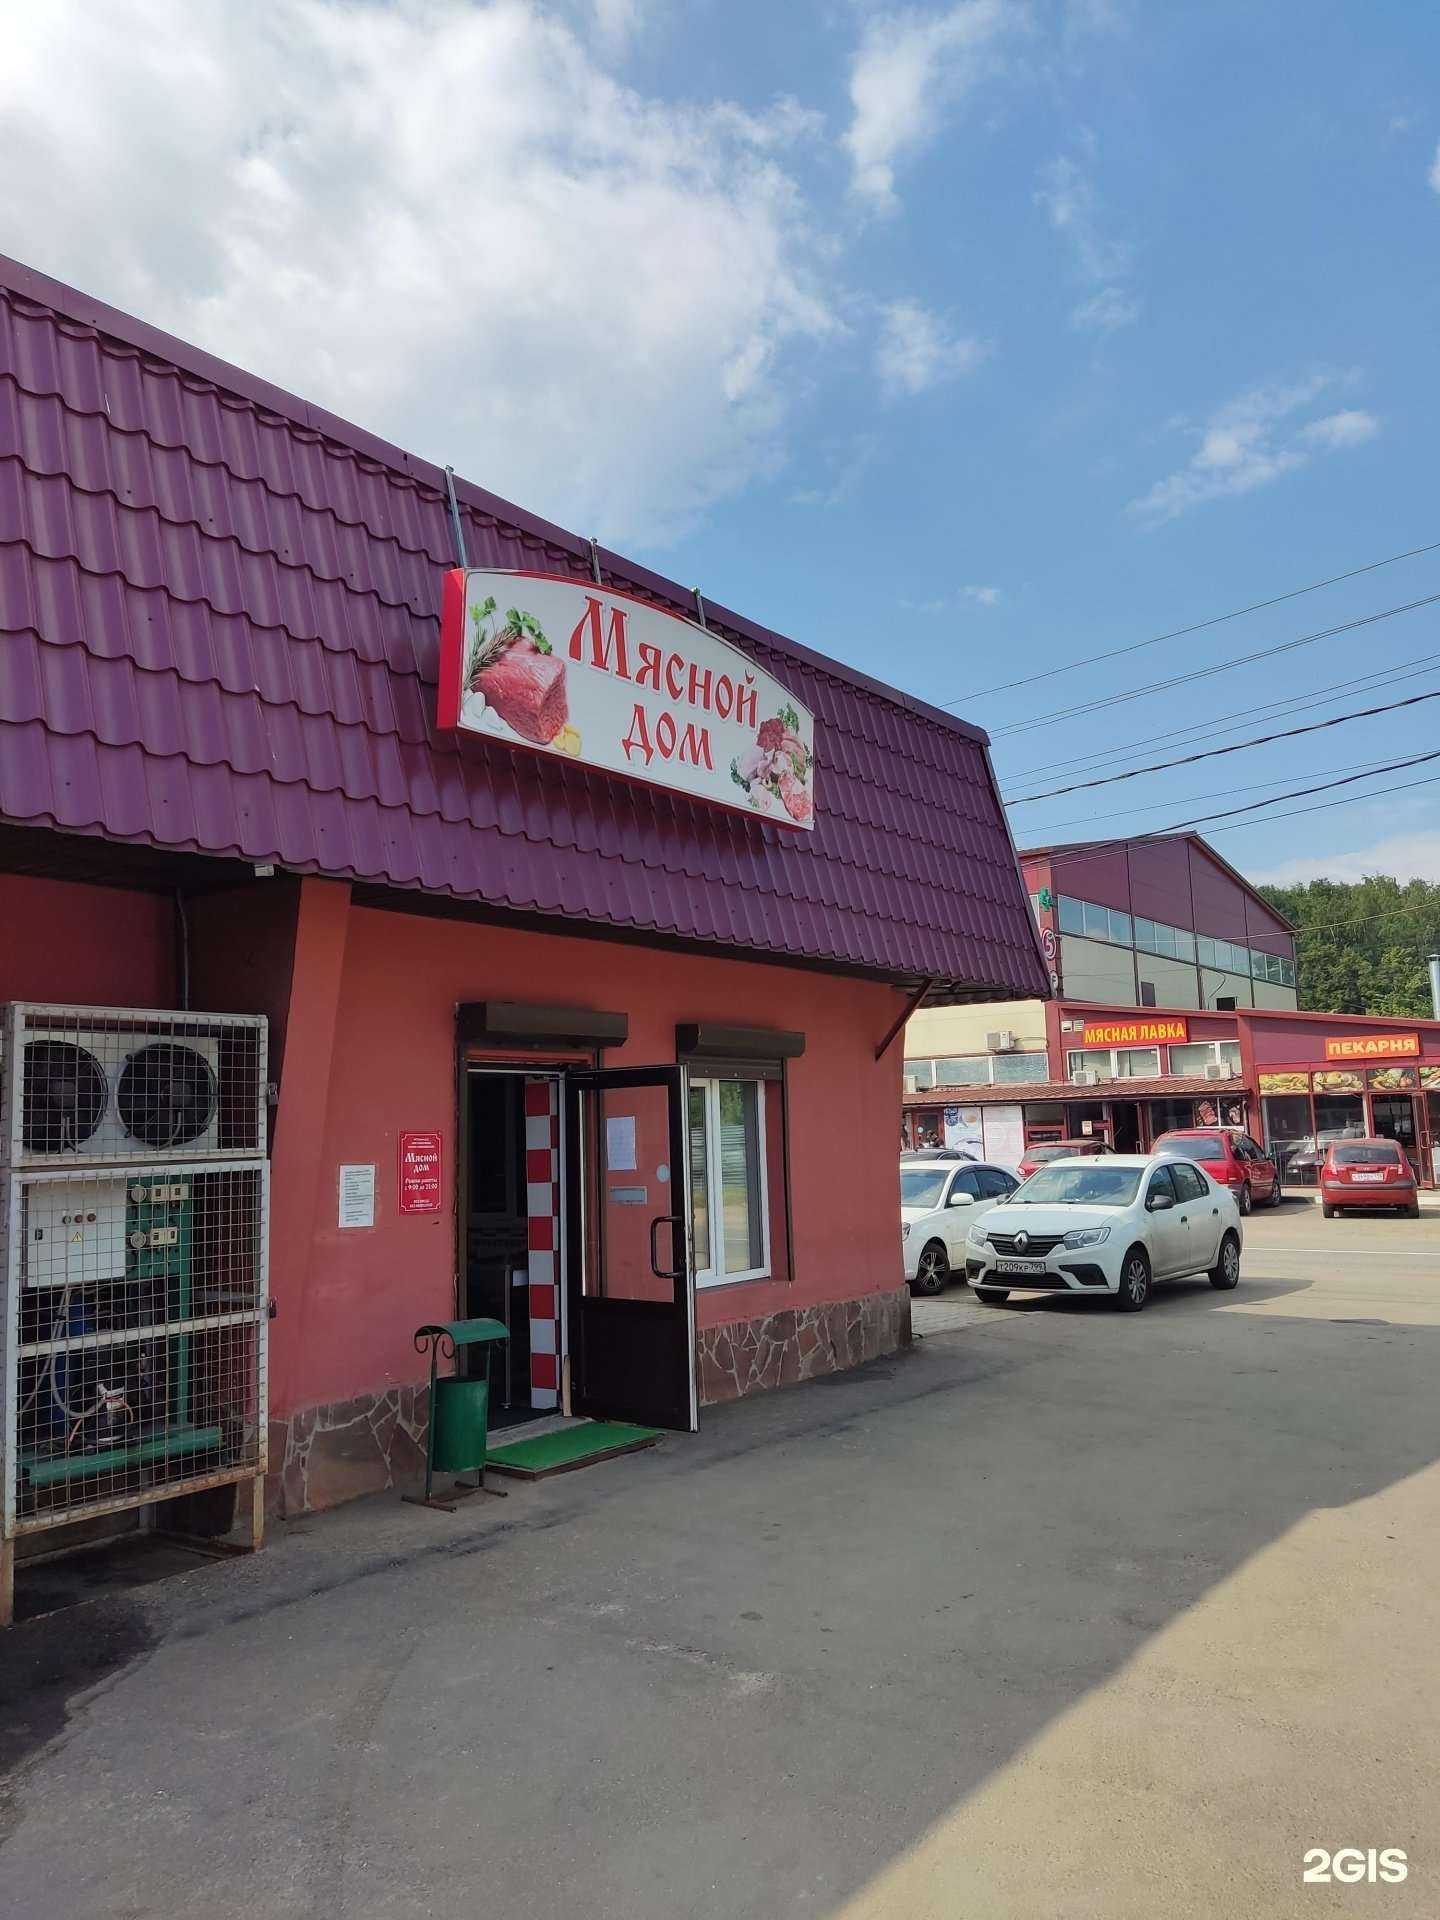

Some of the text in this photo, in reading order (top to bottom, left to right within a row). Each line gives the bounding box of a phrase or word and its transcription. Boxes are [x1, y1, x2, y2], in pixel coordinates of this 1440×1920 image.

[569, 596, 759, 728] Мясной
[1085, 1022, 1185, 1043] МЯСНАЯ ЛАВКА
[1328, 1038, 1416, 1056] ПЕКАРНЯ
